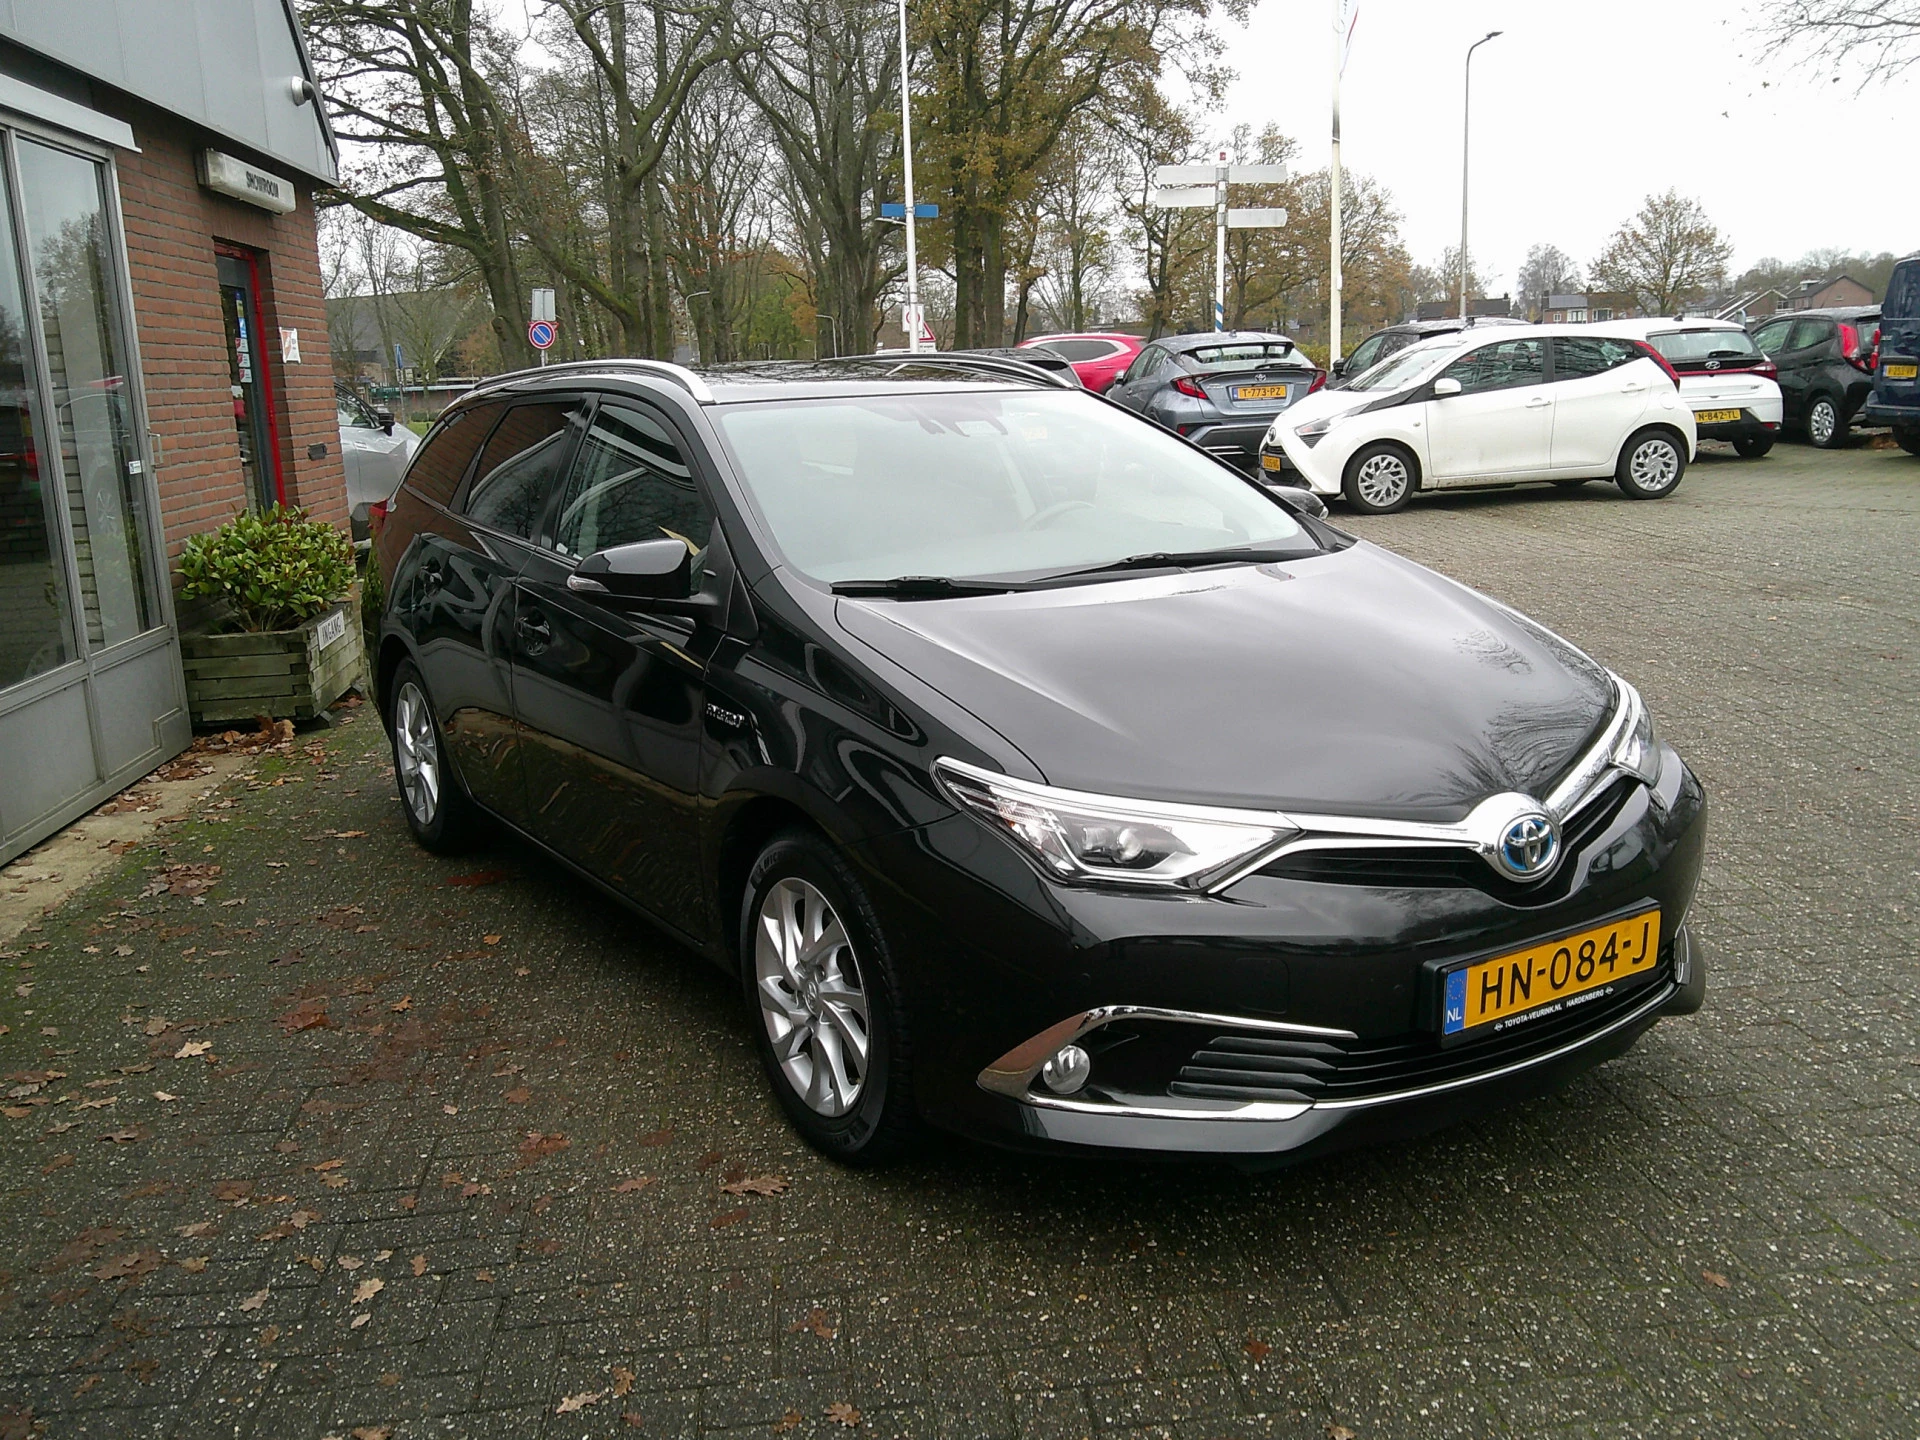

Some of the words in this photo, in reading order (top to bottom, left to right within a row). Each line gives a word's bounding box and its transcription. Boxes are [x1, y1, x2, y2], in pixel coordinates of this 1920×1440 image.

[1242, 387, 1281, 397] T-773-PZ
[1697, 411, 1738, 421] N-842-TL
[1480, 922, 1650, 1014] HN-084-J
[1566, 989, 1604, 1008] HARDENBERG
[1447, 1007, 1462, 1023] NL
